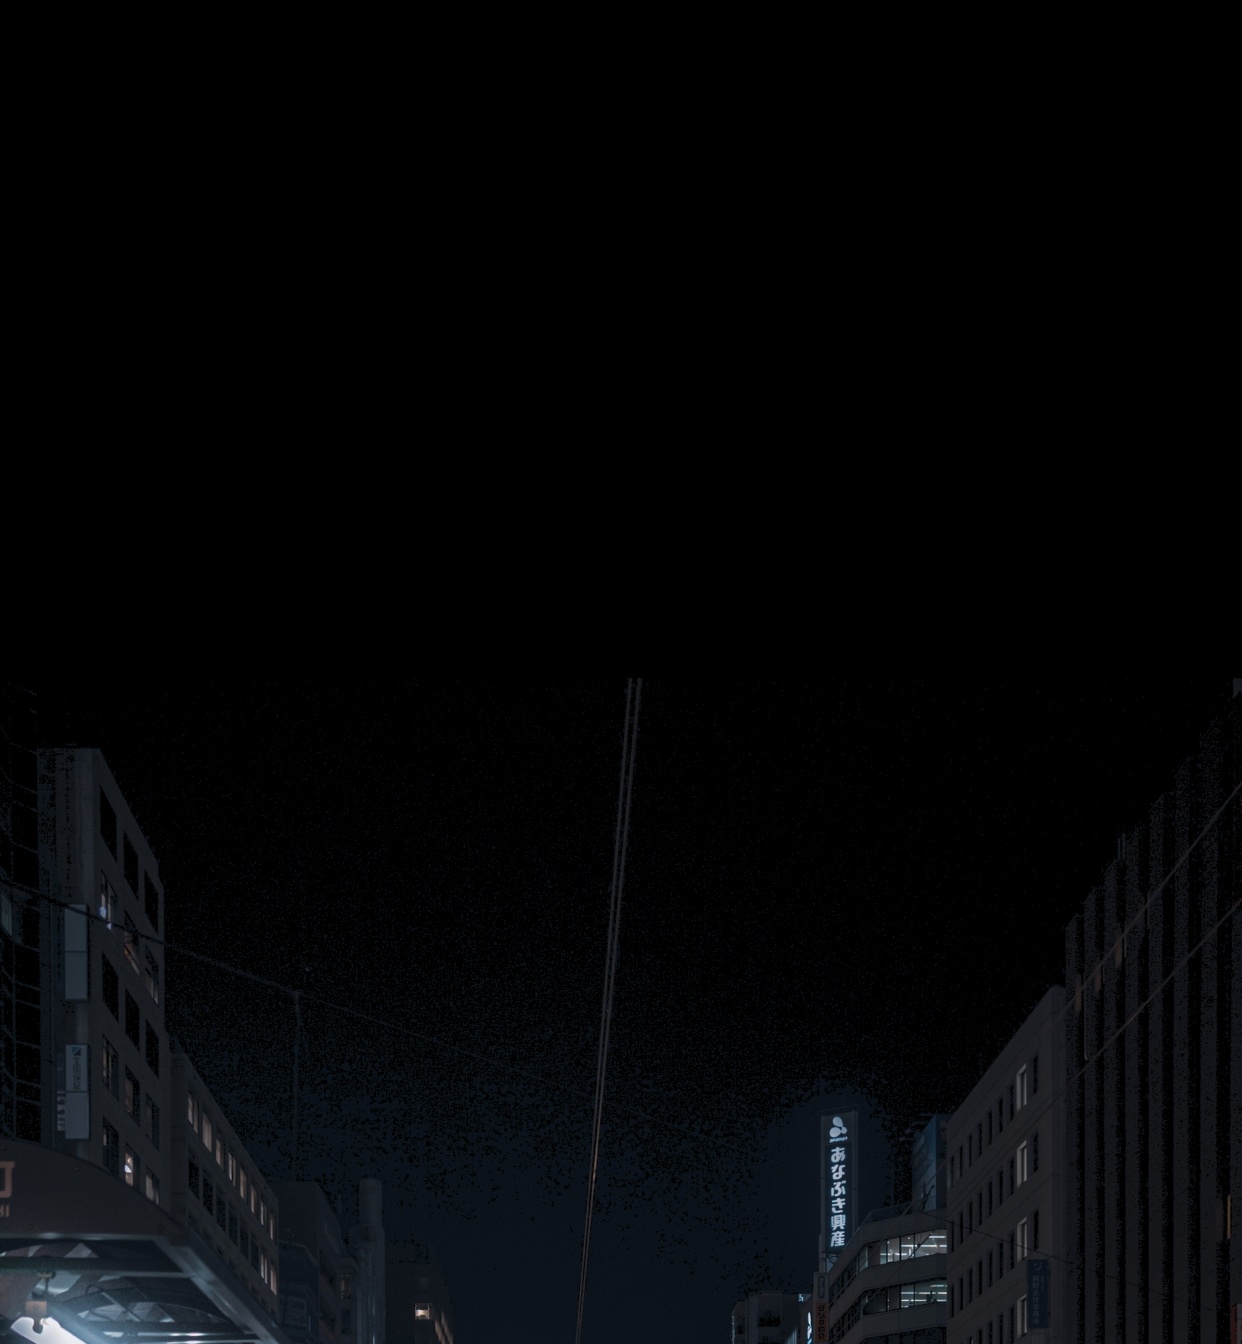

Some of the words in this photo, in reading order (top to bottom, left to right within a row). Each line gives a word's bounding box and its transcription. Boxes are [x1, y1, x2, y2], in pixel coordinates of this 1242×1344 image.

[830, 1146, 847, 1247] あなぶき興産
